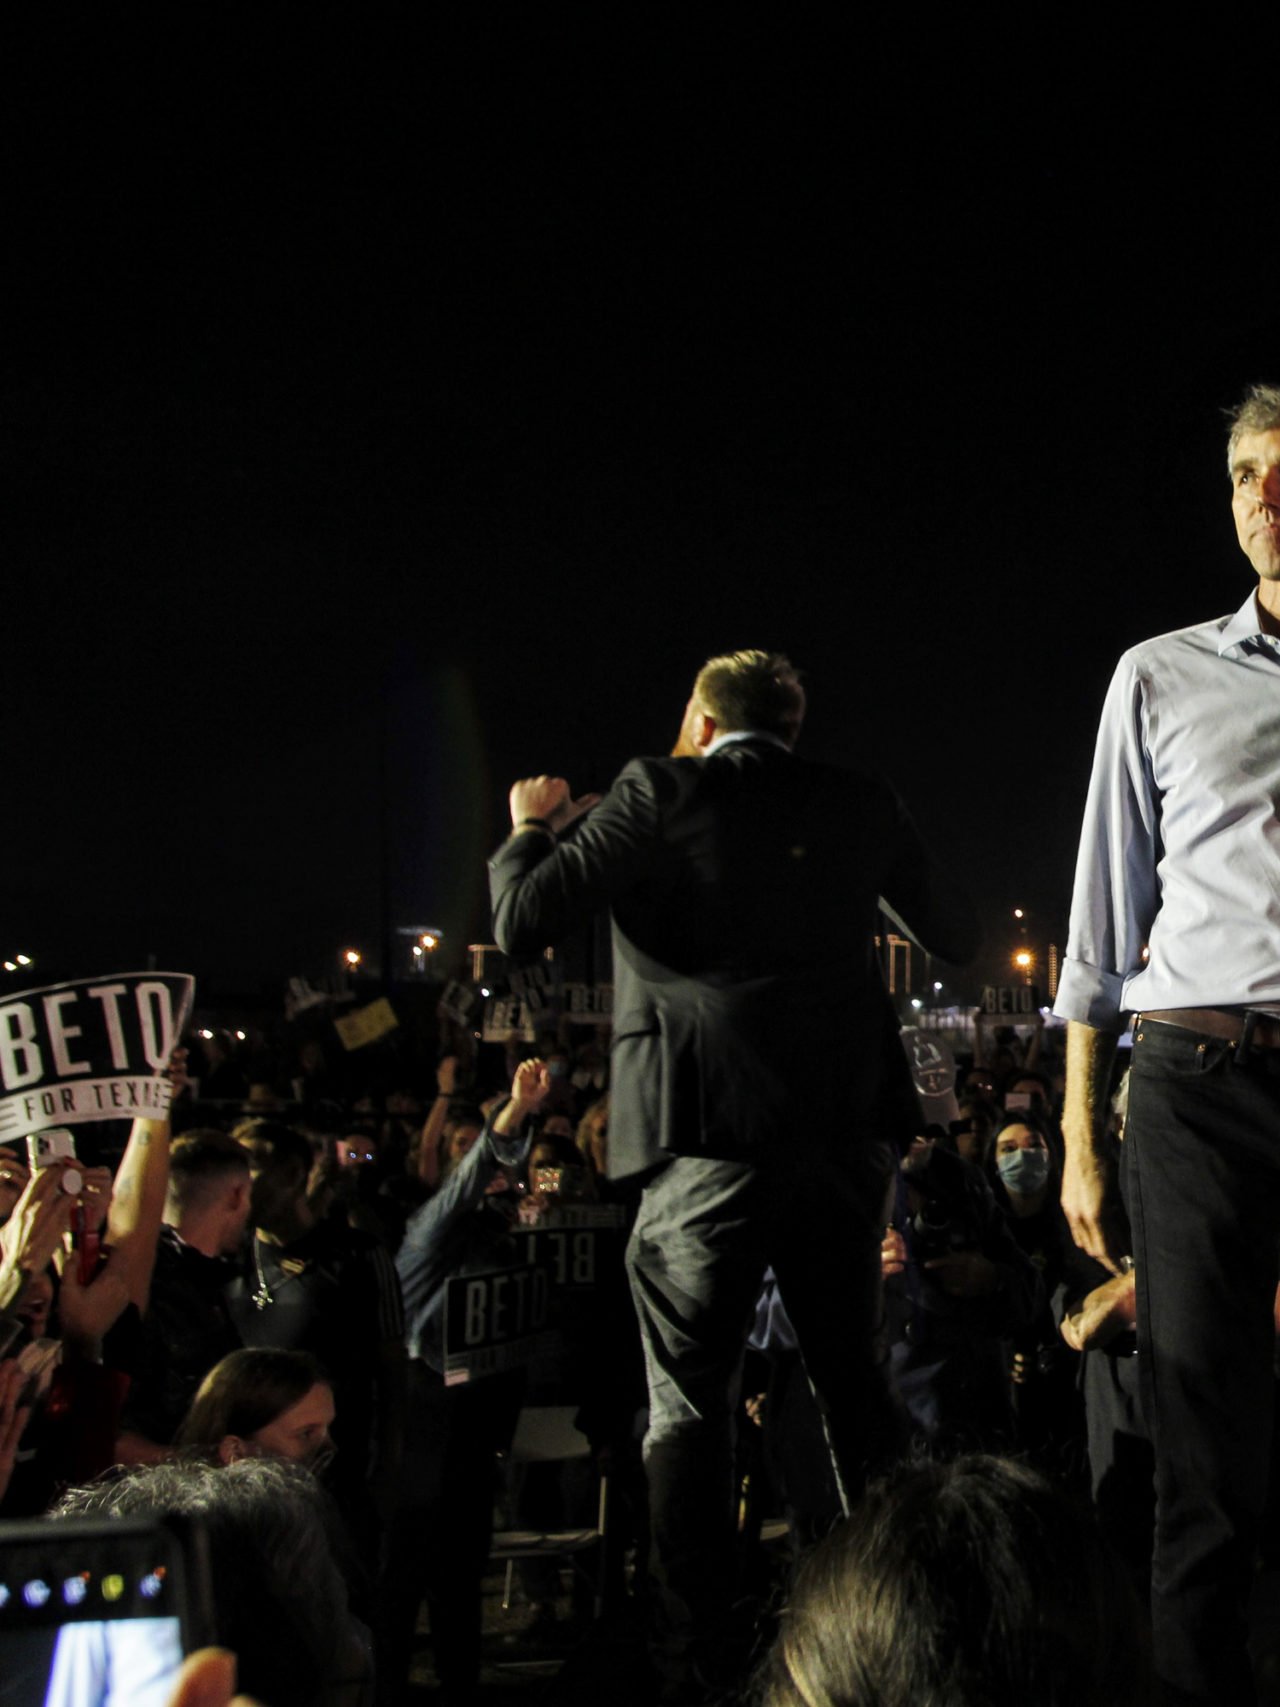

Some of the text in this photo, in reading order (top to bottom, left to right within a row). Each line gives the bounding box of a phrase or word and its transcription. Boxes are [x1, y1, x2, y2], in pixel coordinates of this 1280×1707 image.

[985, 985, 1034, 1013] BETO
[0, 981, 174, 1091] BETO
[23, 1081, 162, 1121] FOR TEXAS
[464, 1267, 548, 1346] BETO
